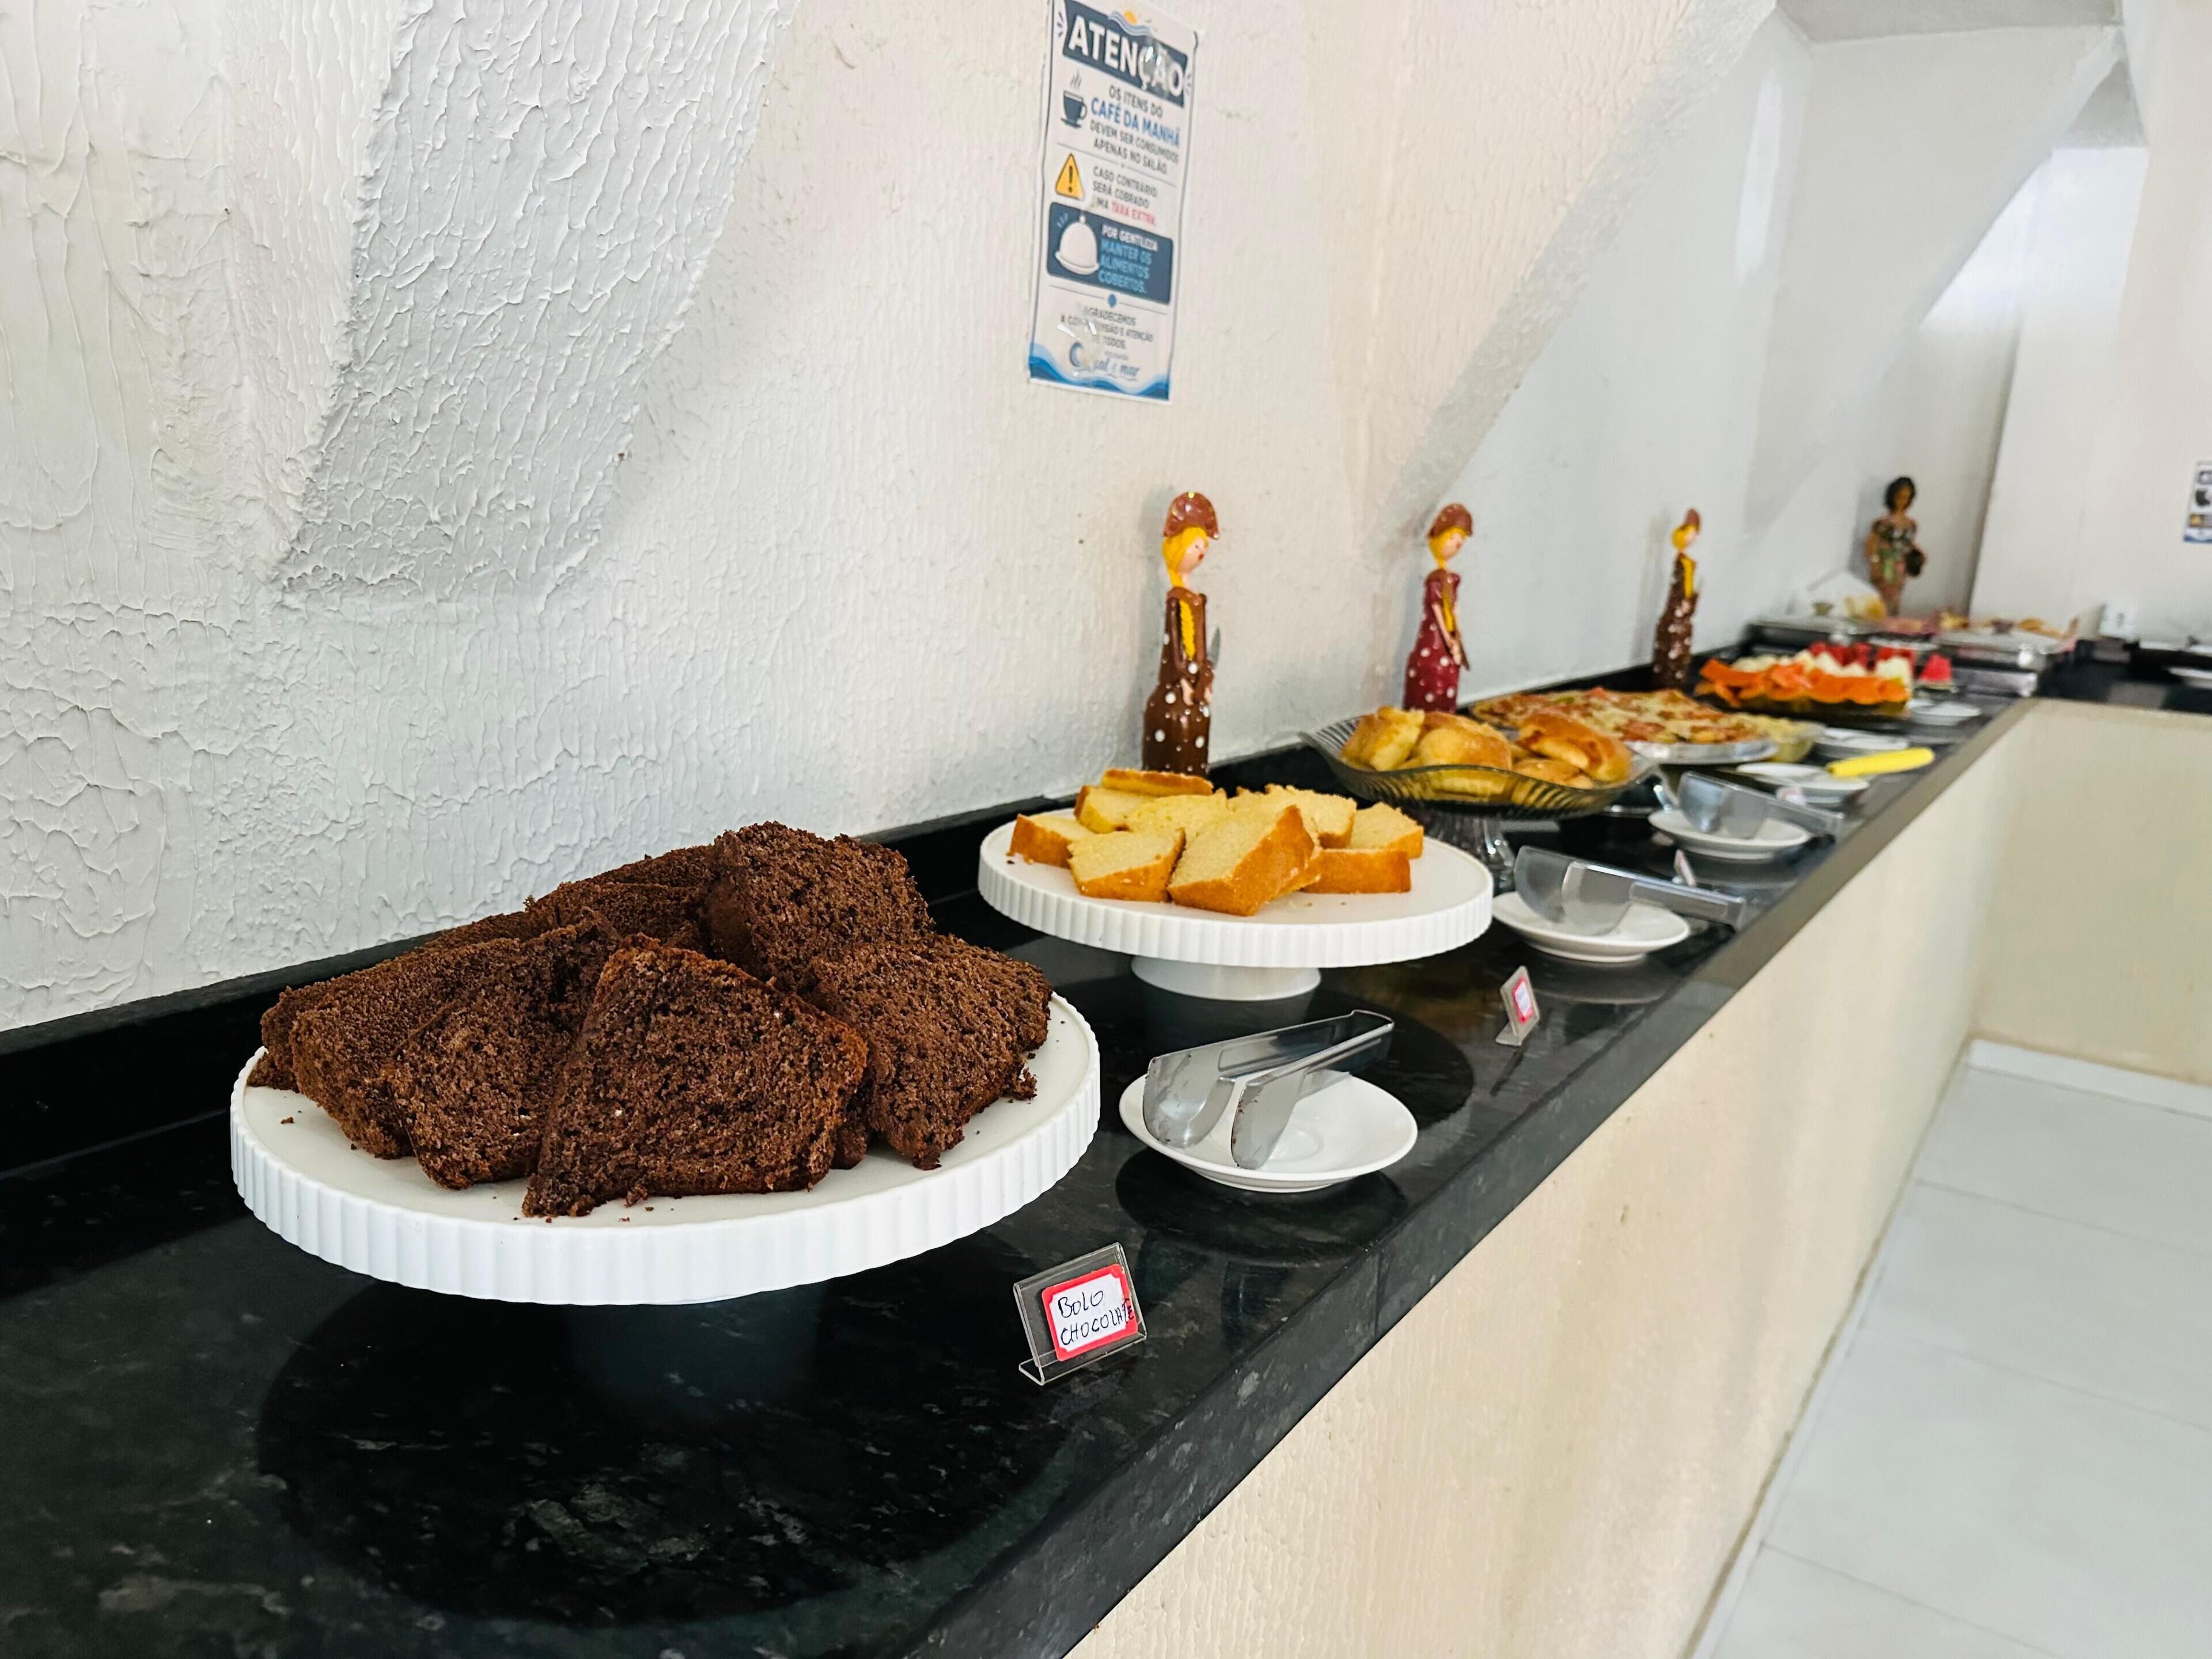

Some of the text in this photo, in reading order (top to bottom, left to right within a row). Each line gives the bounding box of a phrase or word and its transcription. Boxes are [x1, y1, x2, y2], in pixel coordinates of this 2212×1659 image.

[1068, 15, 1183, 97] ATENÇÃO
[1109, 85, 1164, 119] OS ITENS DO
[1090, 119, 1118, 139] DEVEM
[1119, 130, 1134, 145] SER
[1091, 97, 1180, 148] CAFÉ DA MANHÃ
[1094, 138, 1127, 159] APENAS
[1130, 151, 1141, 164] NO
[1093, 165, 1115, 182] CASO
[1058, 1290, 1104, 1319] BOLO
